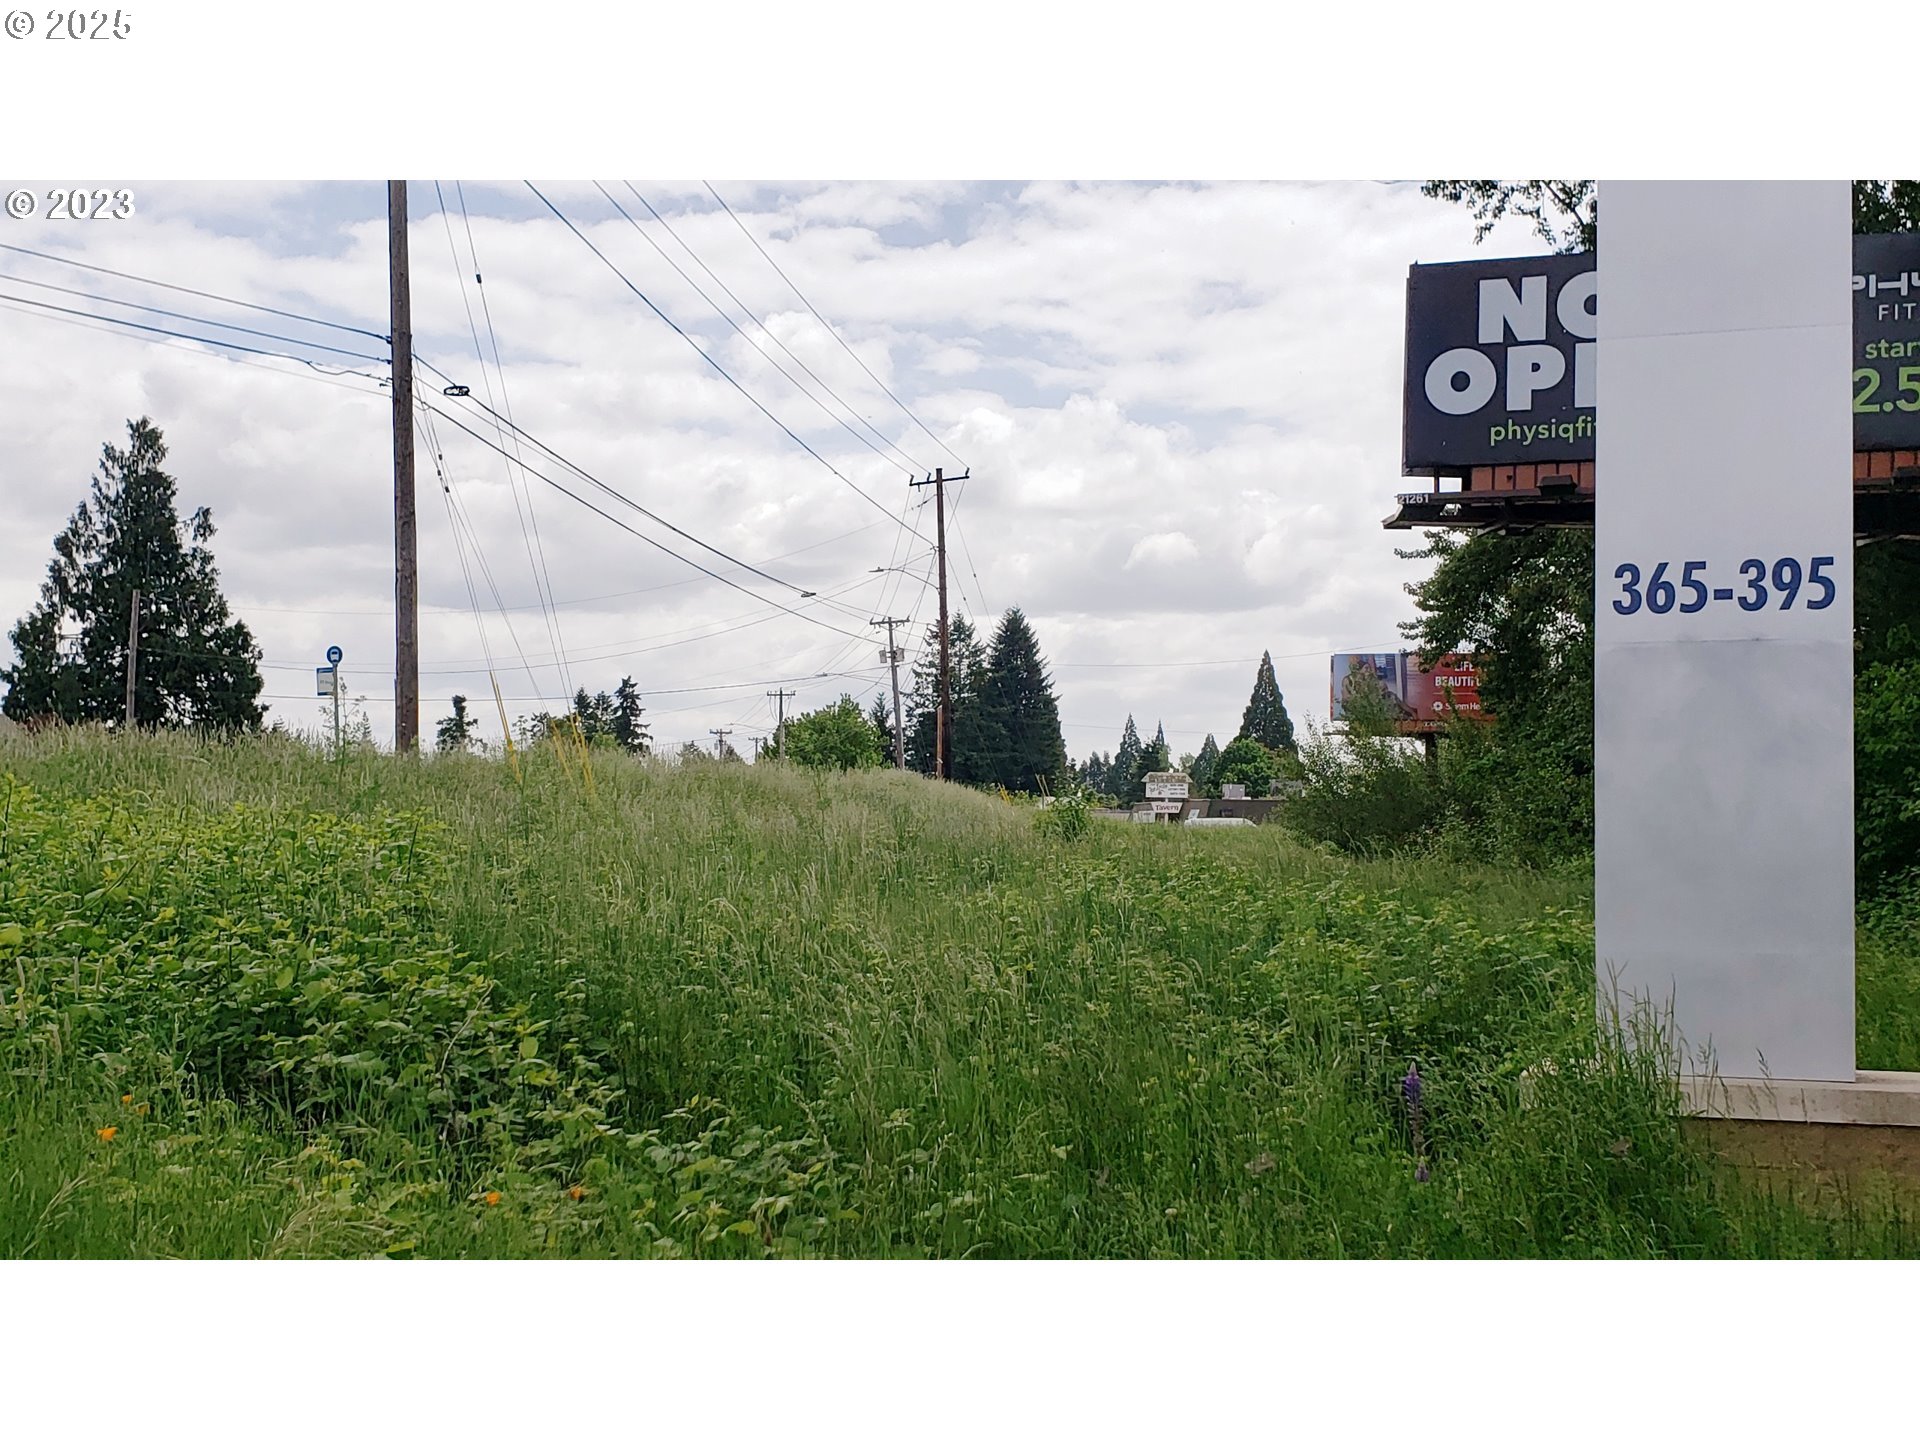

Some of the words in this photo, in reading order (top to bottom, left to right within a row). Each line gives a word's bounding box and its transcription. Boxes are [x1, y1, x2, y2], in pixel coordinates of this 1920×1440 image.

[1864, 338, 1920, 360] star
[1490, 415, 1596, 447] physiqfi
[1398, 493, 1429, 504] 21261
[1612, 556, 1836, 615] 365-395
